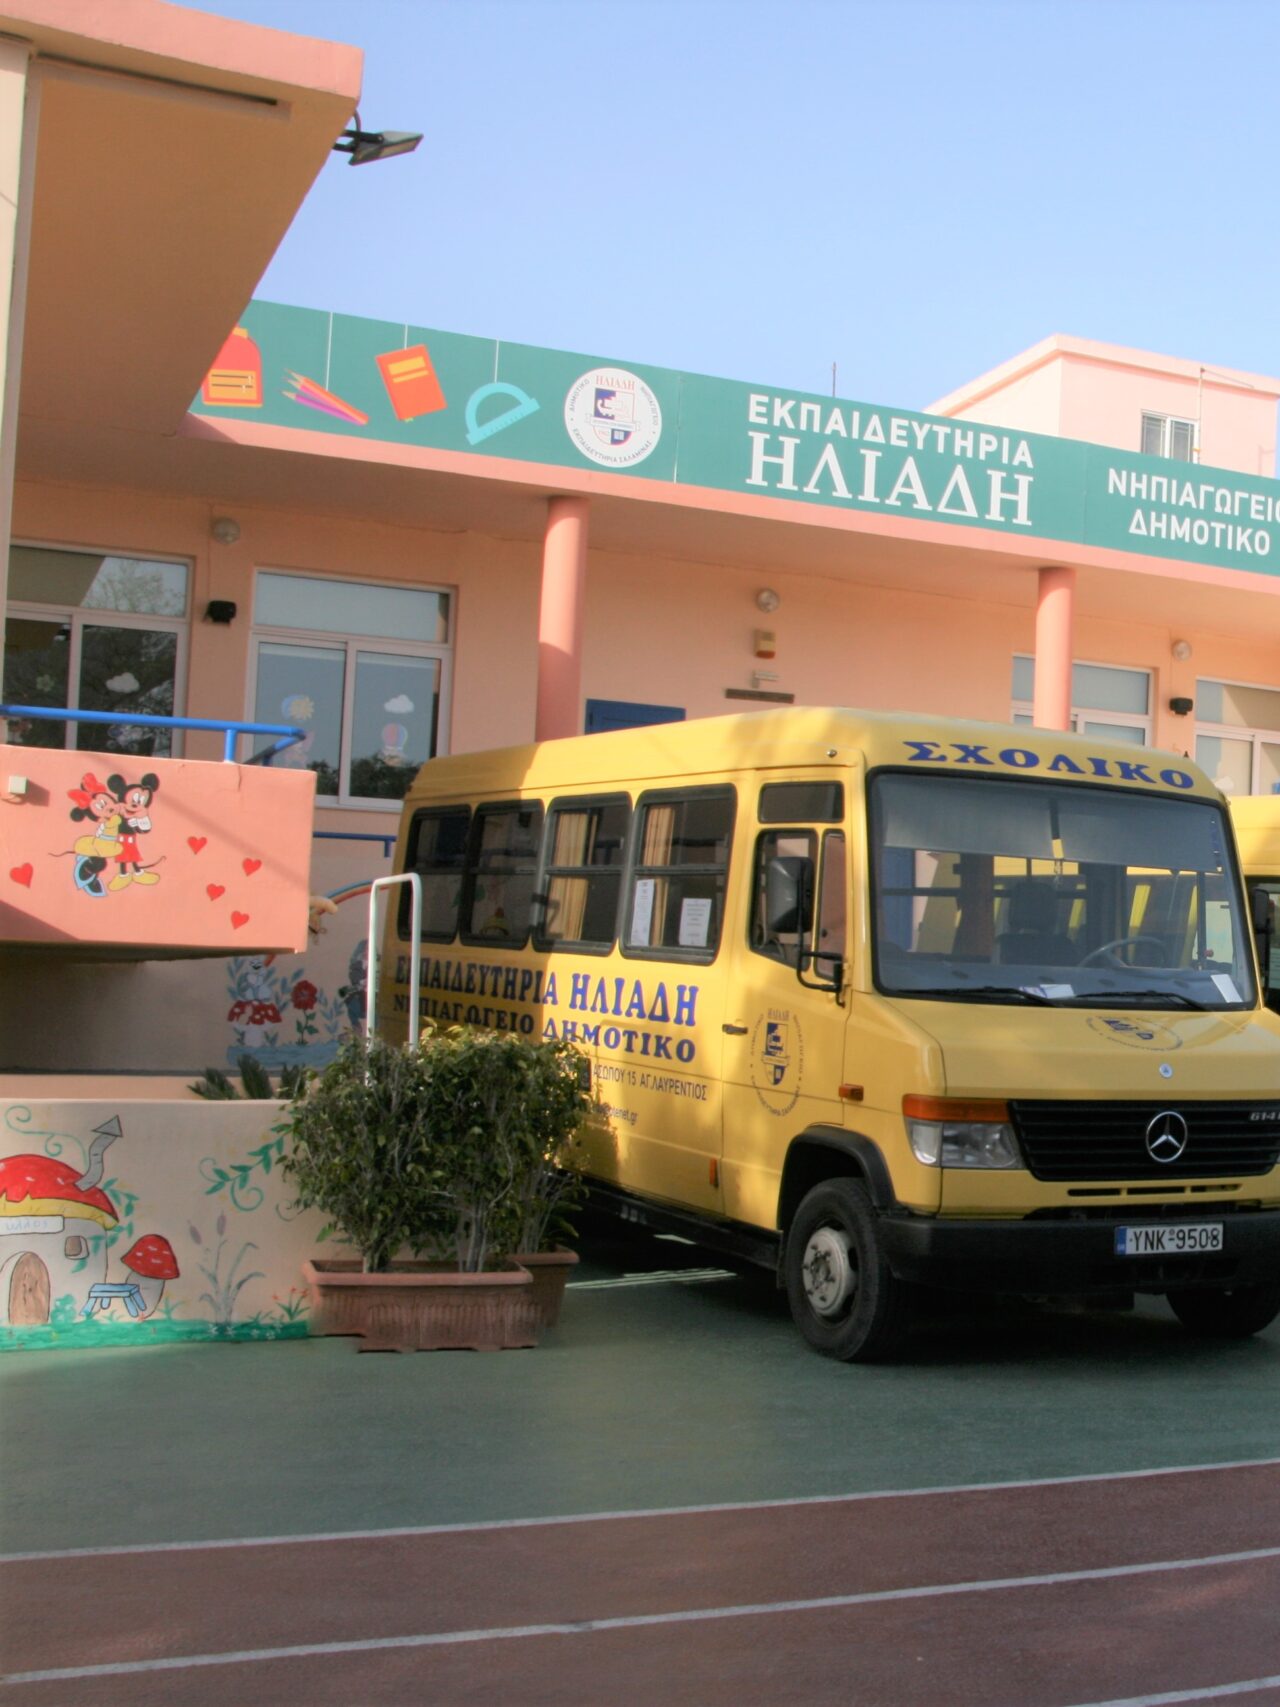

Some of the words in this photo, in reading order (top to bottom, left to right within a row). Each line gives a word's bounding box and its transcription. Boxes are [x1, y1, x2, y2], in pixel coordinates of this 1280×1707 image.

[748, 393, 1034, 469] ΕΚΠΑΙΔΕΥΤΗΡΙΑ
[745, 431, 1034, 526] ΗΛΙΑΔΗ
[1128, 508, 1271, 556] ΔΗΜΟΤΙΚΟ
[902, 741, 1194, 789] ΣΧΟΛΙΚΟ
[569, 972, 699, 1027] ΗΛΙΑΔΗ
[542, 1017, 696, 1063] ΔΗΜΟΤΙΚΟ
[627, 1070, 637, 1087] 15
